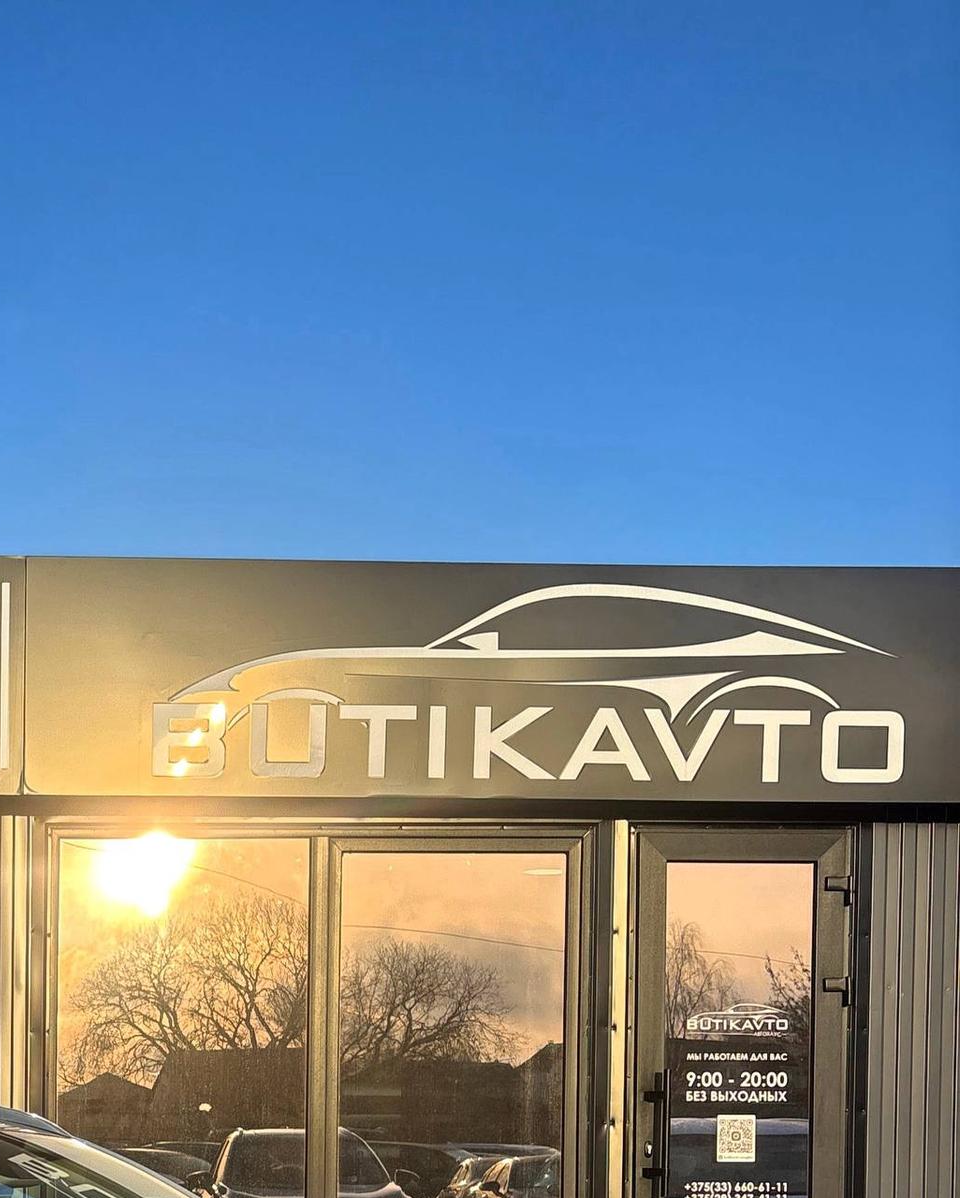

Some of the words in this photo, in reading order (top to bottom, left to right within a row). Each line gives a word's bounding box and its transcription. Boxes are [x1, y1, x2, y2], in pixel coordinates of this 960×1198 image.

[151, 702, 905, 784] BUTIKAVTO
[686, 1019, 789, 1031] BUTIKAVTO
[686, 1052, 702, 1061] МЫ
[703, 1052, 749, 1061] РАБОТАЕМ
[749, 1053, 768, 1062] ДЛЯ
[769, 1053, 788, 1061] ВАС
[686, 1071, 723, 1087] 9:00
[740, 1071, 788, 1087] 20:00
[685, 1091, 707, 1102] БЕЗ
[710, 1091, 787, 1103] ВЫХОДНЫХ
[684, 1182, 732, 1194] +375(33)
[734, 1182, 788, 1192] 660-61-11
